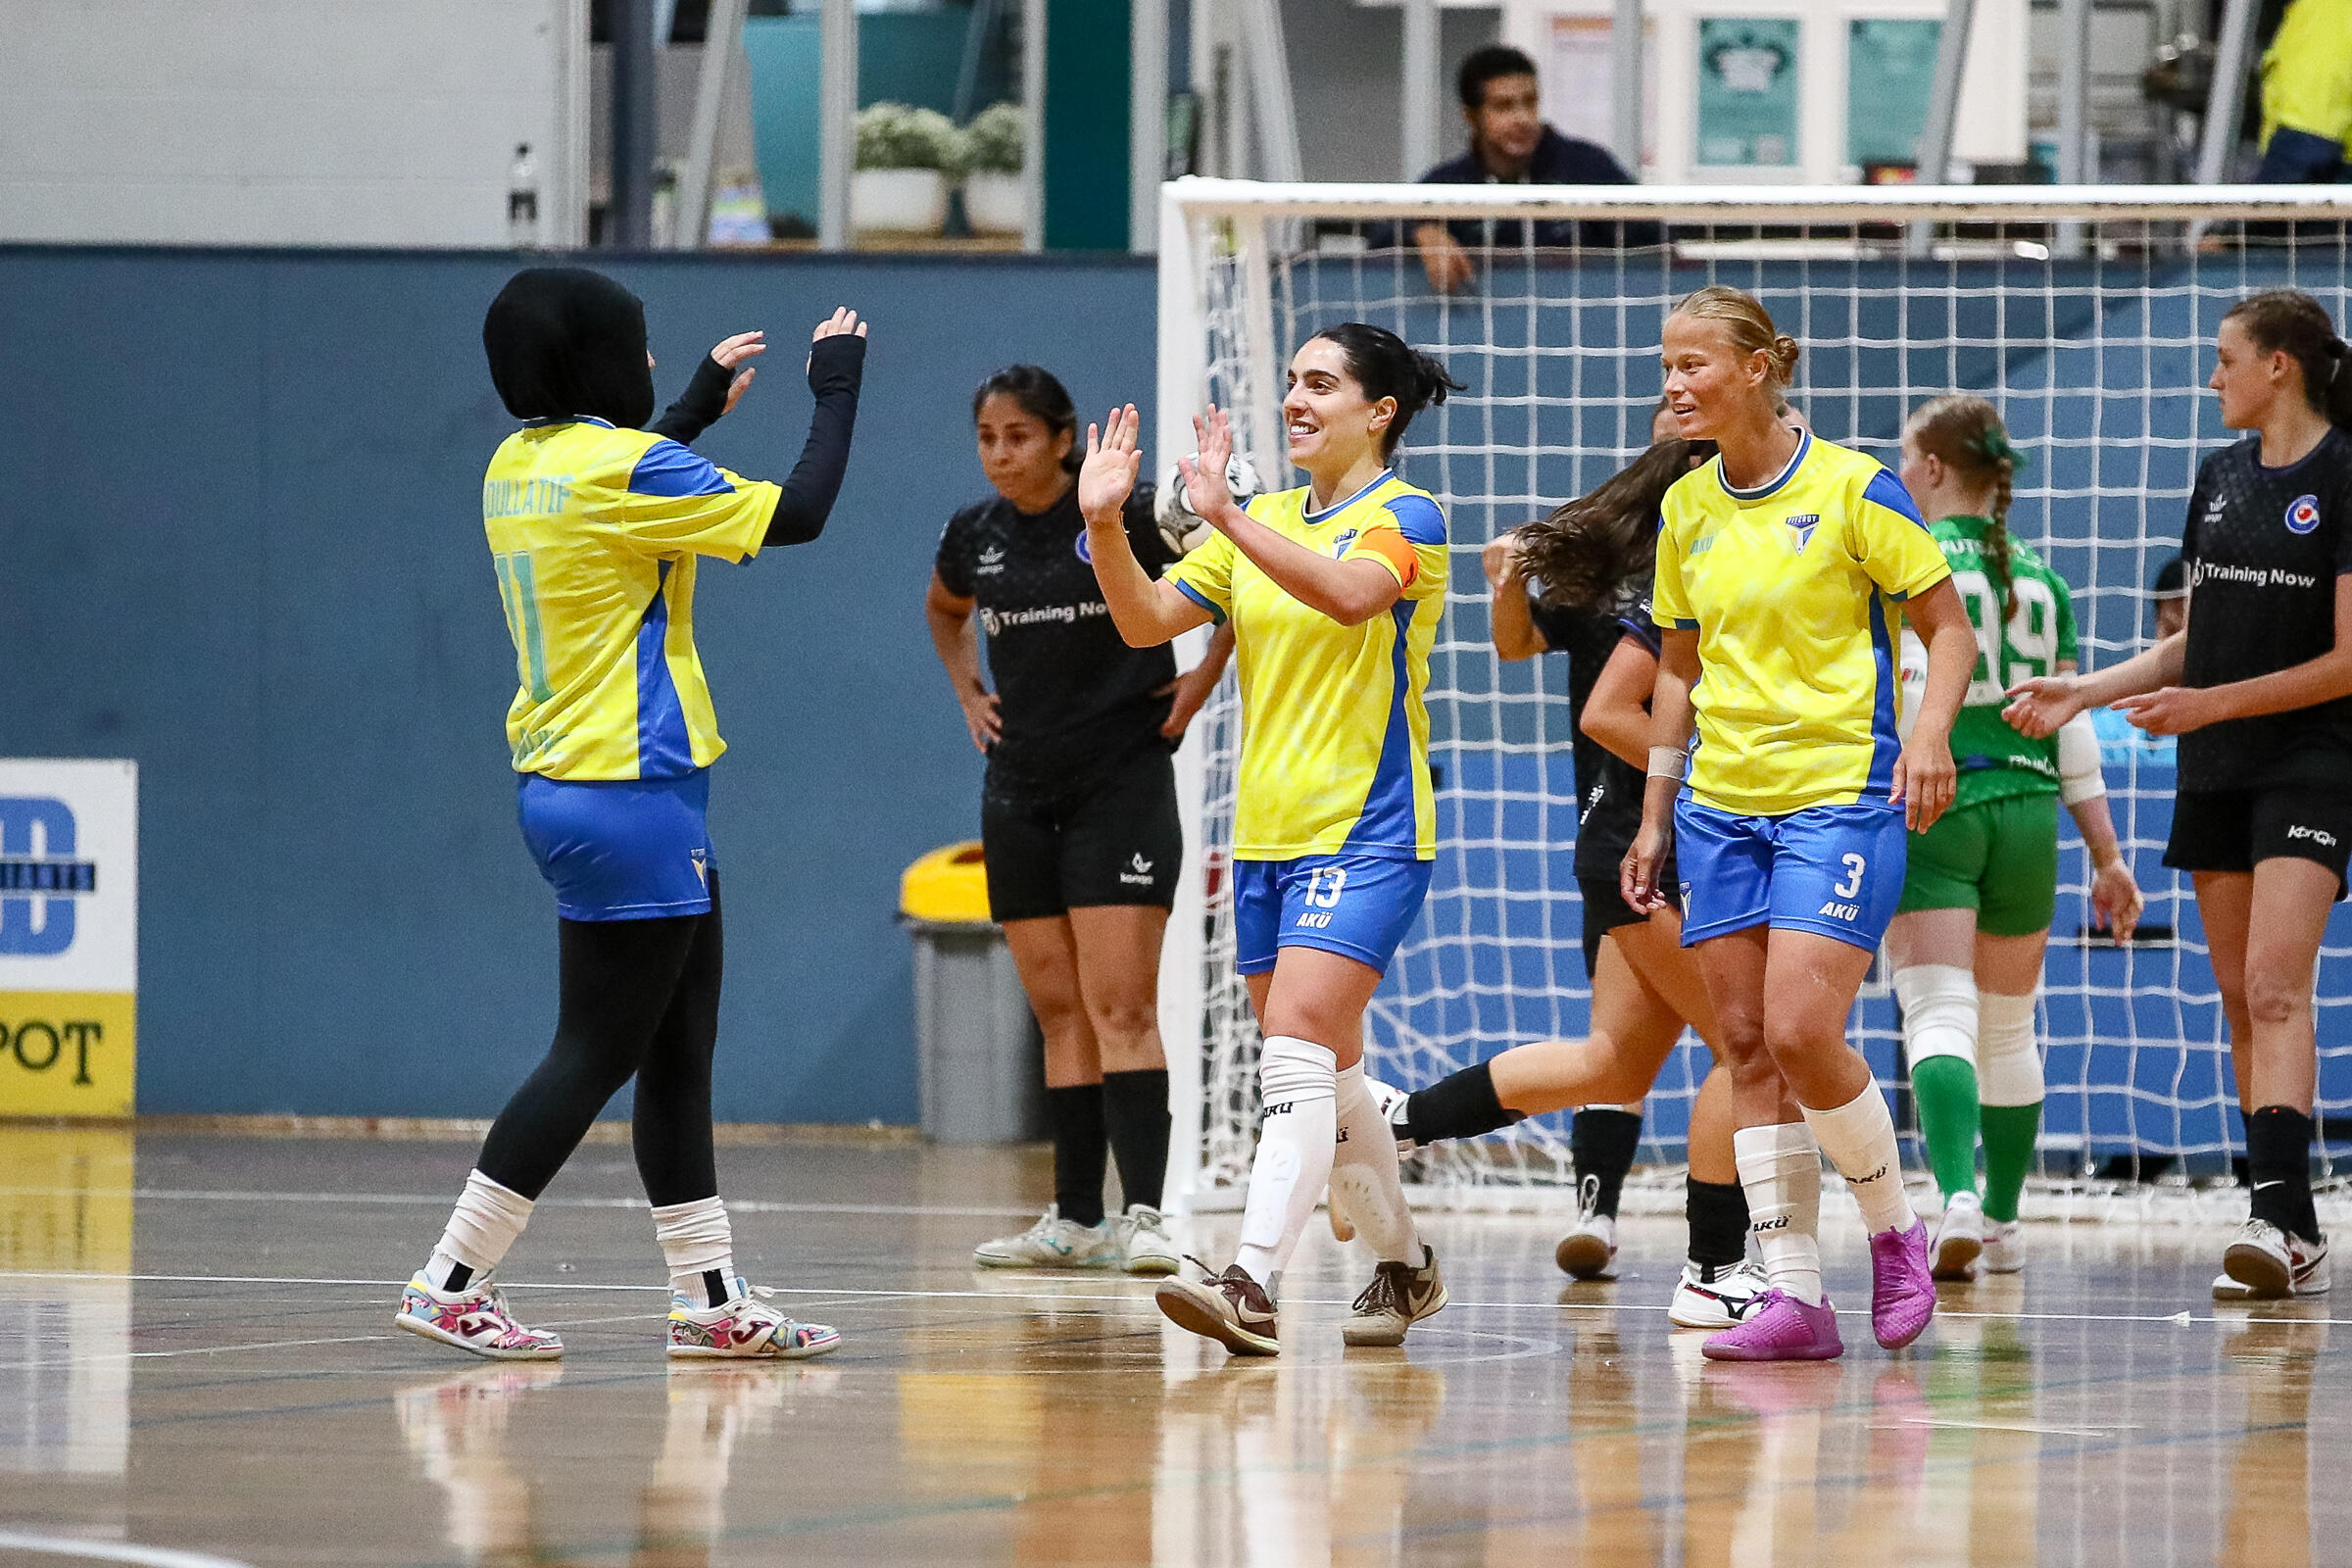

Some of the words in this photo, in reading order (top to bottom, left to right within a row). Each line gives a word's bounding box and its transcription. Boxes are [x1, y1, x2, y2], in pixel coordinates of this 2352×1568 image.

[2205, 563, 2268, 587] Training
[2271, 568, 2316, 588] Now
[493, 551, 555, 703] 11
[999, 605, 1076, 624] Training
[1078, 601, 1108, 616] No
[1304, 866, 1348, 908] 13
[1834, 852, 1866, 900] 3
